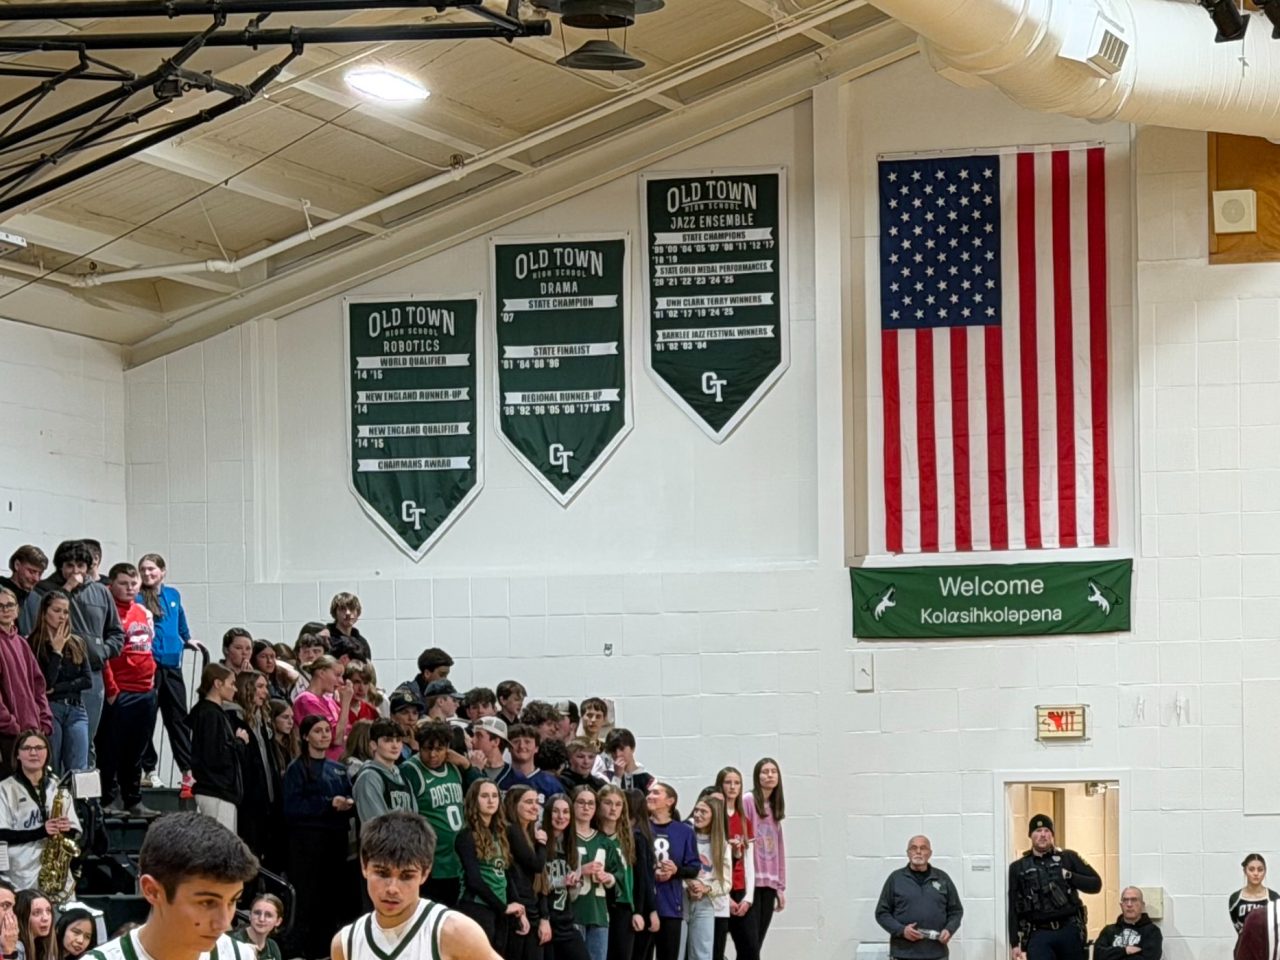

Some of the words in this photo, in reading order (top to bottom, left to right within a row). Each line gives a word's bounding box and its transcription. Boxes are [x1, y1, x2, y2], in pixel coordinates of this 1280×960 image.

[667, 183, 701, 213] OLD
[705, 181, 757, 210] TOWN
[670, 216, 696, 230] JAZZ
[700, 213, 754, 228] ENSEMBLE
[682, 233, 702, 242] STATE
[704, 232, 746, 241] CHAMPIONS
[736, 242, 747, 251] '11
[750, 241, 761, 250] '12
[763, 240, 775, 249] '17
[515, 249, 549, 279] OLD
[553, 247, 603, 277] TOWN
[660, 266, 678, 275] STATE
[679, 265, 696, 274] GOLD
[697, 264, 718, 274] MEDAL
[719, 262, 768, 273] PERFORMANCES
[666, 277, 678, 286] '21
[680, 277, 692, 285] '22
[694, 276, 706, 285] '23
[708, 276, 720, 284] '24
[722, 275, 735, 284] '25
[540, 281, 578, 295] DRAMA
[528, 299, 550, 309] STATE
[552, 298, 594, 308] CHAMPION
[682, 297, 705, 306] CLARK
[707, 296, 728, 306] TERRY
[729, 295, 762, 305] WINNERS
[500, 313, 514, 322] '07
[680, 309, 692, 318] '17
[708, 308, 720, 317] '24
[722, 307, 734, 316] '25
[368, 308, 402, 338] OLD
[405, 306, 455, 336] TOWN
[692, 329, 705, 338] JAZZ
[706, 328, 735, 338] FESTIVAL
[737, 327, 768, 336] WINNERS
[383, 339, 440, 353] ROBOTICS
[533, 346, 555, 356] STATE
[557, 345, 591, 355] FINALIST
[380, 357, 407, 367] WORLD
[408, 356, 447, 366] QUALIFIER
[354, 370, 367, 380] '14
[370, 370, 383, 379] '15
[365, 391, 384, 401] NEW
[384, 390, 418, 400] ENGLAND
[420, 389, 462, 400] RUNNER-UP
[521, 393, 558, 402] REGIONAL
[560, 391, 602, 402] RUNNER-UP
[354, 404, 368, 414] '14
[517, 405, 531, 415] '92
[547, 405, 560, 414] '05
[577, 404, 589, 413] '17
[368, 426, 386, 436] NEW
[387, 425, 421, 435] ENGLAND
[422, 424, 459, 435] QUALIFIER
[355, 439, 368, 448] '14
[370, 439, 384, 448] '15
[378, 460, 422, 470] CHAIRMANS
[424, 459, 451, 469] AWARD
[938, 575, 1045, 597] Welcome
[446, 805, 463, 832] 0
